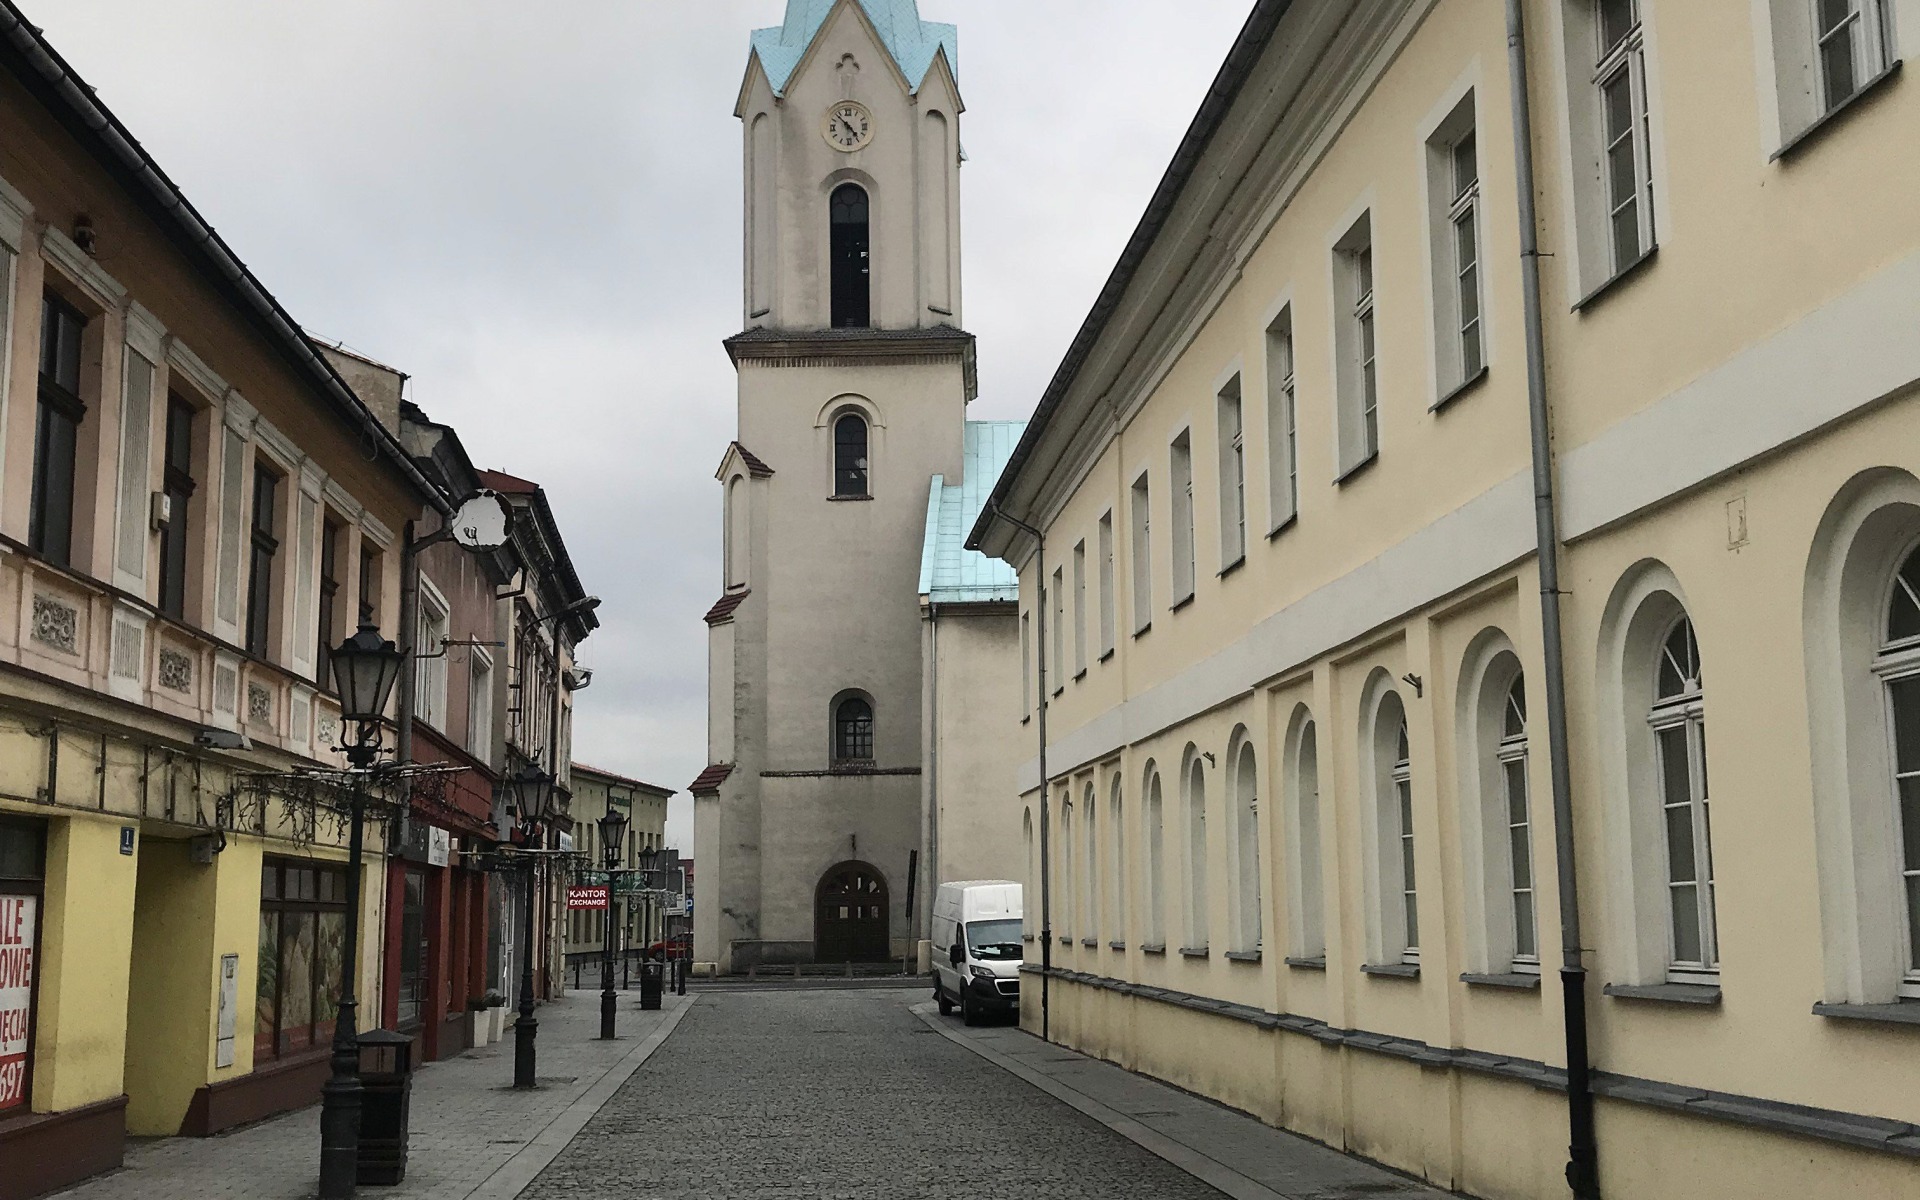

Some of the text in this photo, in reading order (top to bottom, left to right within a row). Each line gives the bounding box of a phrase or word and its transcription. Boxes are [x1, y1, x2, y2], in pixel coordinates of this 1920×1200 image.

[125, 830, 130, 845] 1
[569, 890, 606, 898] KANTOR
[685, 899, 693, 910] P
[0, 1060, 25, 1101] 697
